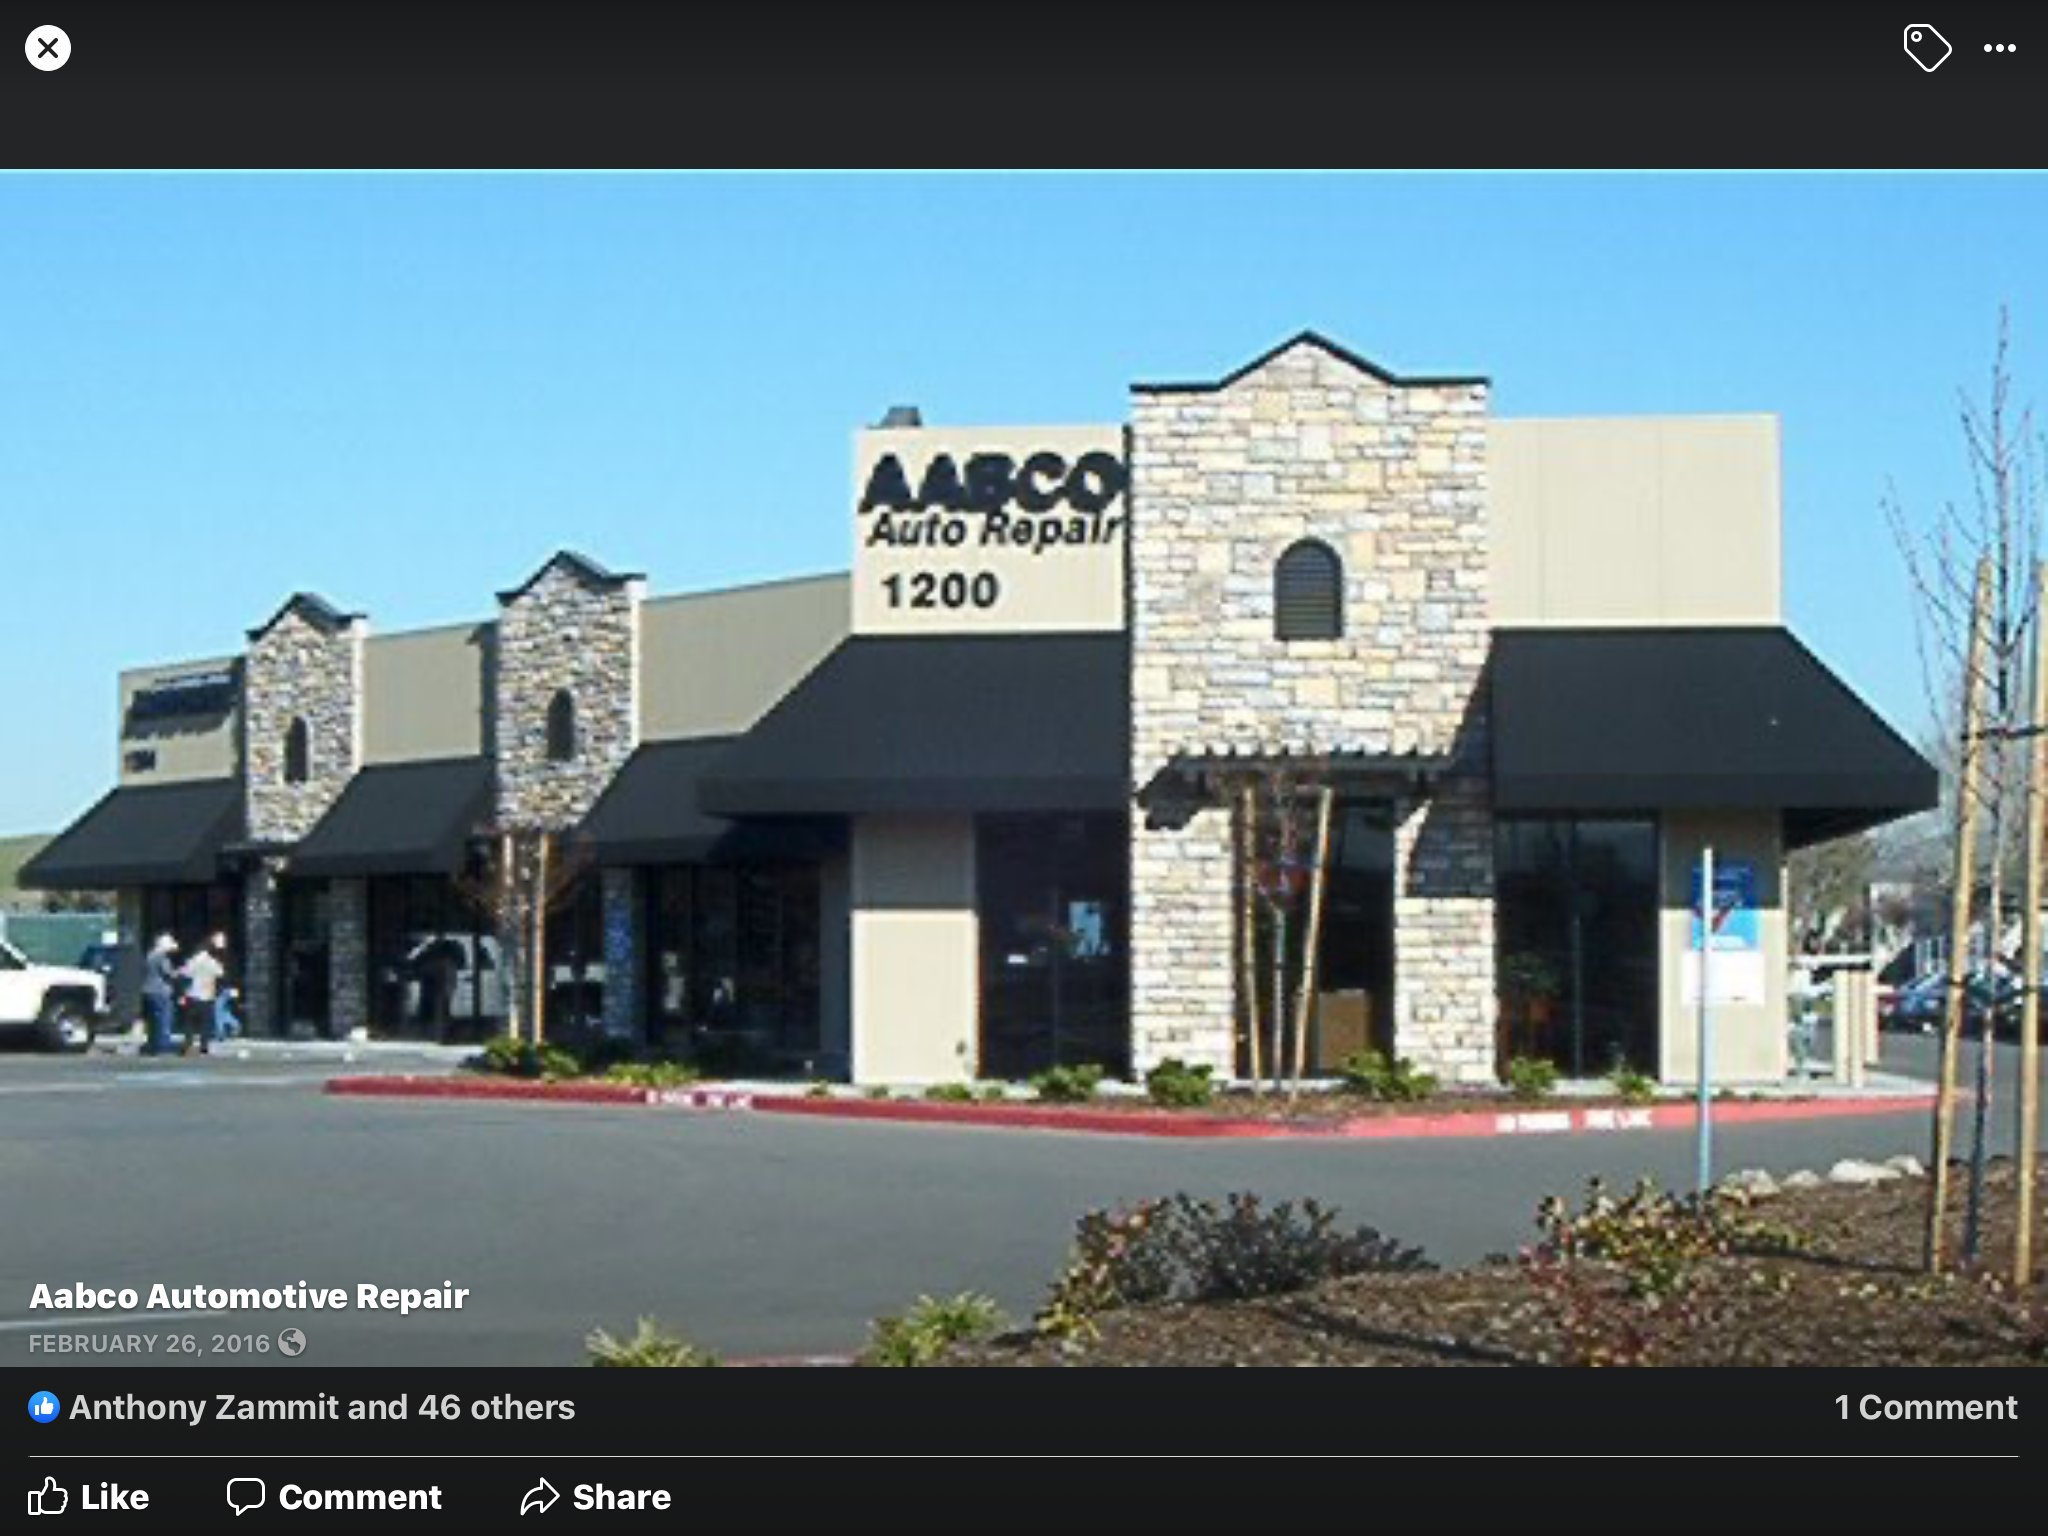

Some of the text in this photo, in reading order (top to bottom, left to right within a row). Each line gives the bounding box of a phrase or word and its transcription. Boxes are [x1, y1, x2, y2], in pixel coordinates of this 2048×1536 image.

[858, 452, 1128, 513] AABCO
[866, 510, 1123, 555] Auto Repair
[881, 572, 1000, 609] 1200
